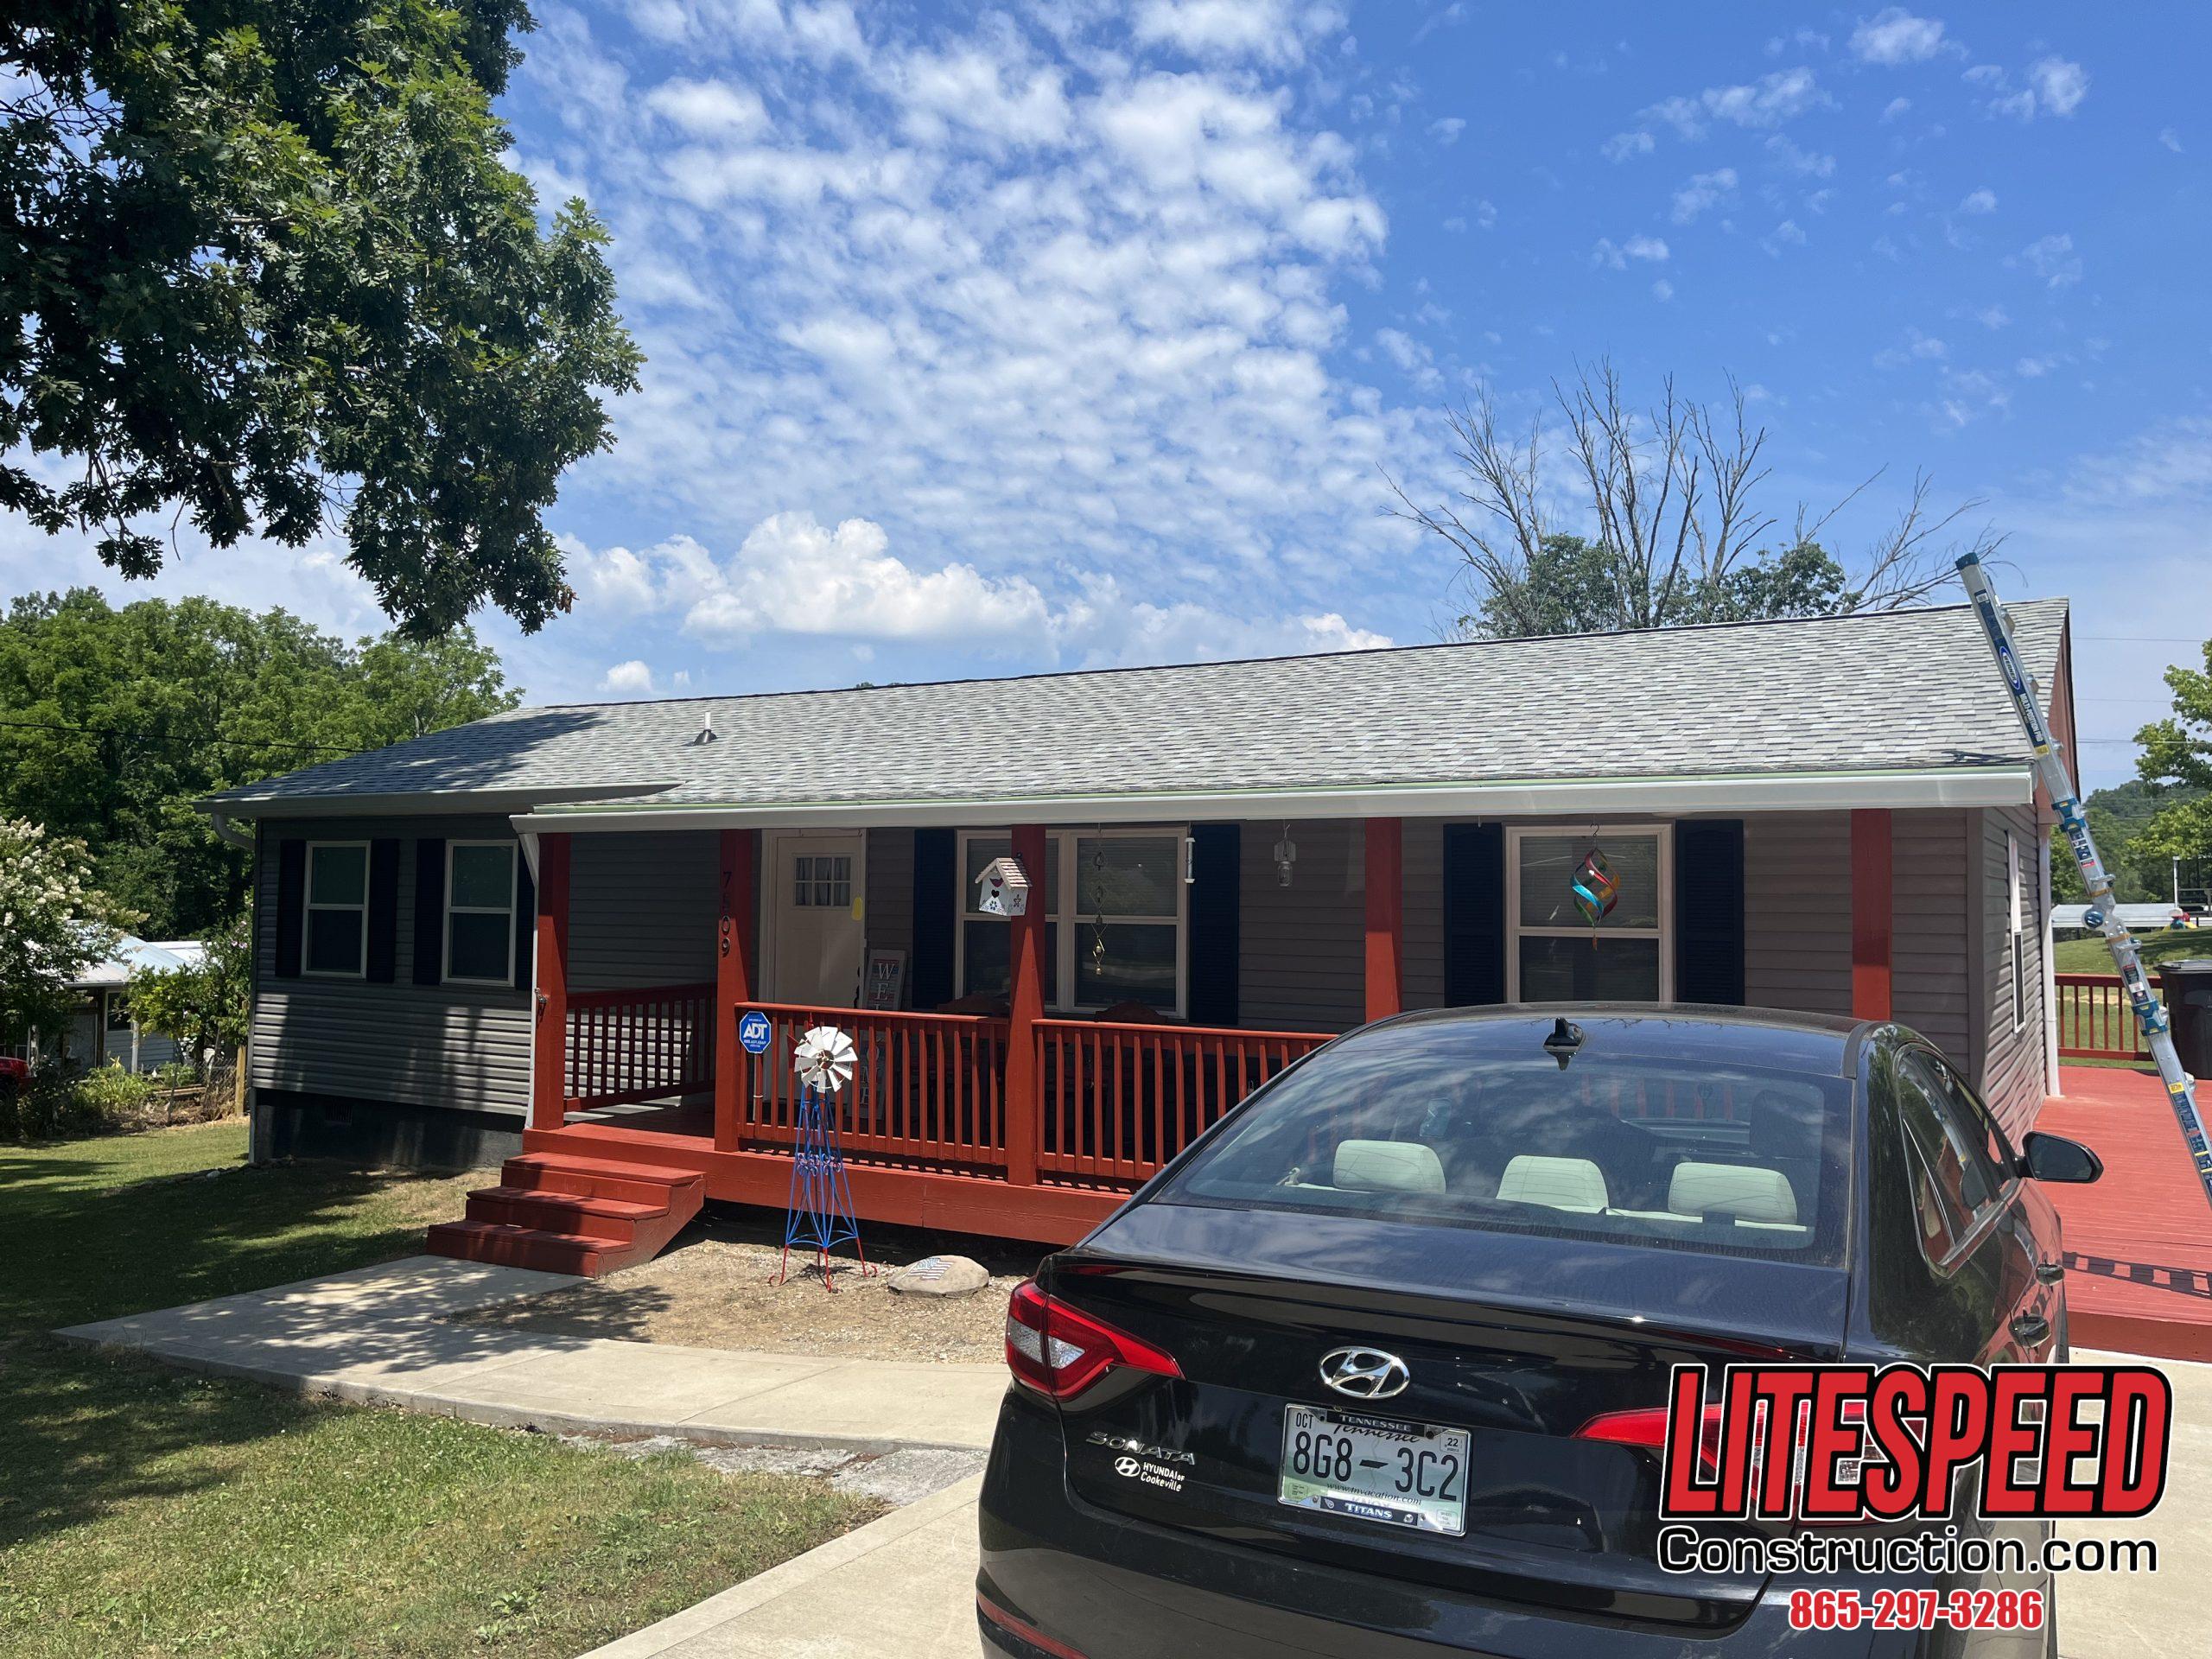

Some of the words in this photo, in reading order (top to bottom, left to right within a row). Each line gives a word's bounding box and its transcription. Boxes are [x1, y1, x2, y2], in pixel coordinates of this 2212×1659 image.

[743, 1023, 767, 1039] ADT
[1296, 1413, 1313, 1429] OCT
[1341, 1415, 1411, 1432] TENNESSEE
[1334, 1424, 1421, 1443] Tennessee
[1447, 1438, 1459, 1447] 22
[1086, 1431, 1195, 1465] SONATA
[1142, 1462, 1178, 1478] HYUNDAI
[1294, 1431, 1353, 1482] 8G8
[1395, 1447, 1459, 1502] 3C2
[1141, 1471, 1182, 1492] Cookeville
[1326, 1482, 1422, 1506] www.tnvacation.com
[1344, 1502, 1393, 1520] TITANS
